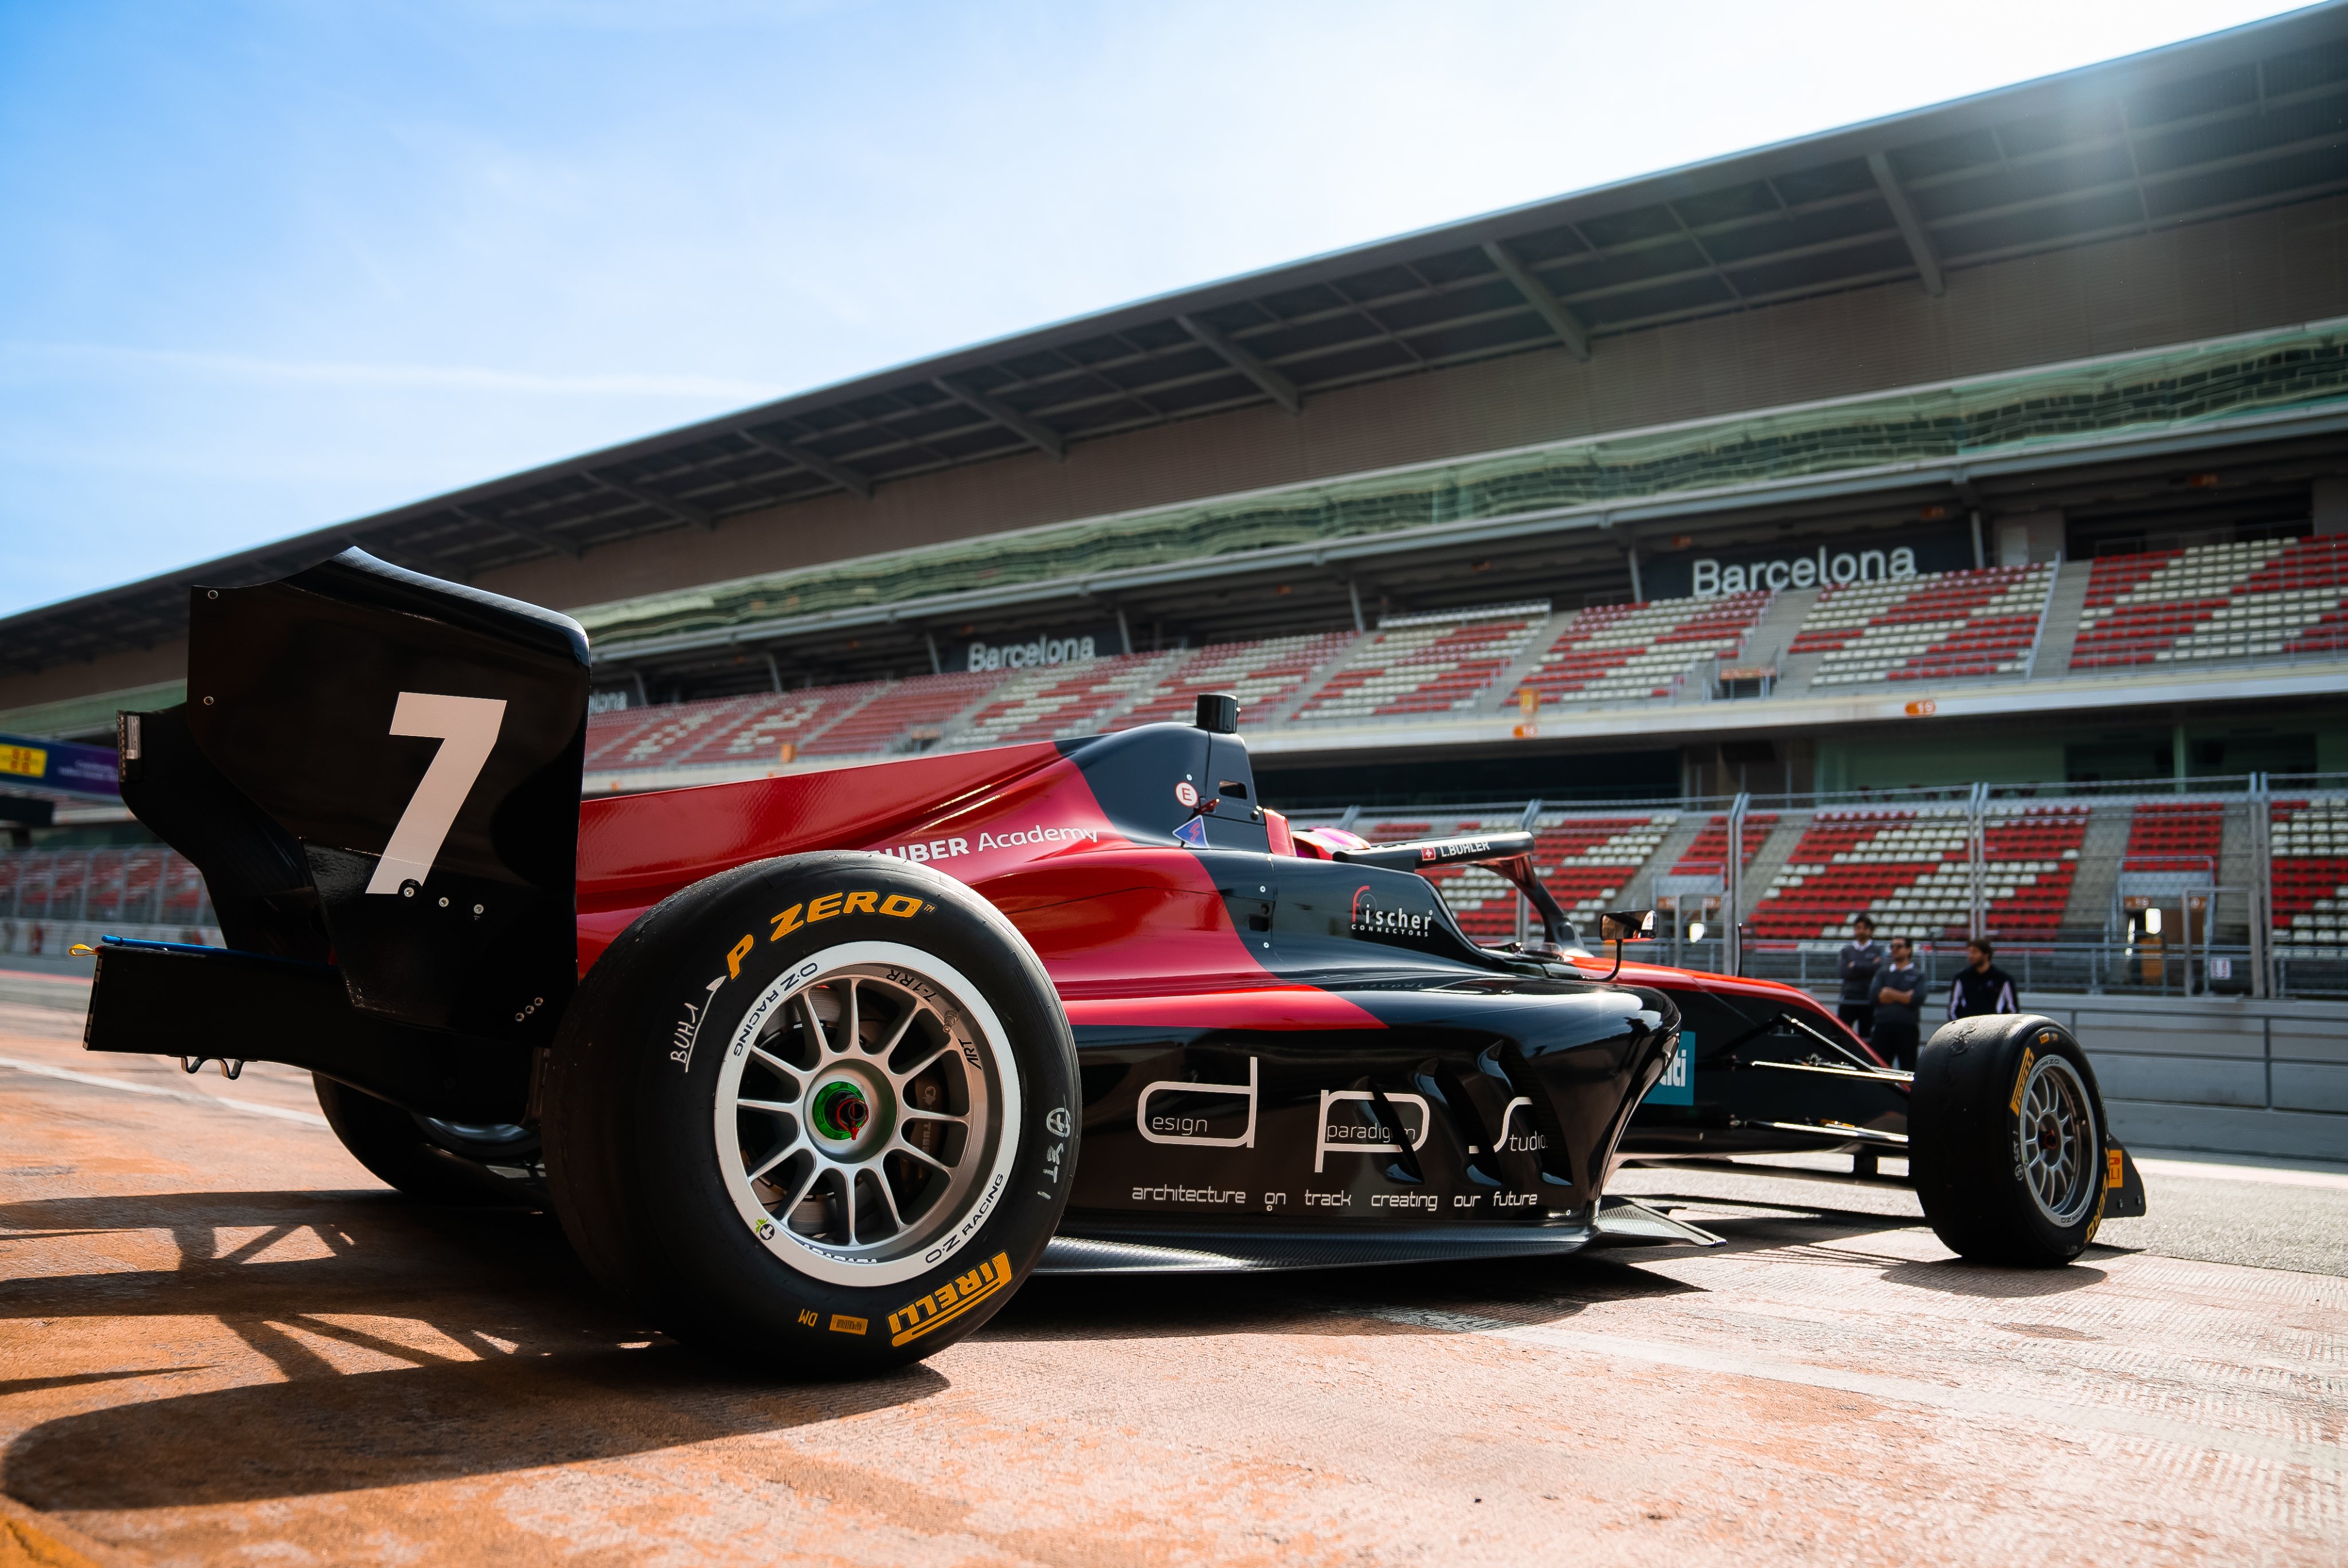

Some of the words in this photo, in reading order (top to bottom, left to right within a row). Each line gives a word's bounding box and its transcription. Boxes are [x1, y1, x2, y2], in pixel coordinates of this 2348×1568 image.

[1693, 545, 1916, 597] Barcelona
[967, 633, 1096, 672] Barcelona
[366, 692, 507, 893] 7
[1181, 787, 1192, 801] E
[978, 825, 1098, 852] Academy
[727, 935, 754, 980] P
[770, 892, 923, 942] ZERO
[1351, 924, 1429, 937] CONNECTORS
[733, 989, 779, 1057] RACING
[961, 1173, 1004, 1236] RACING
[1132, 1183, 1246, 1204] architecture
[1265, 1191, 1286, 1205] on
[1305, 1190, 1352, 1207] track
[1371, 1191, 1438, 1212] creating
[1454, 1195, 1481, 1208] our
[1493, 1191, 1538, 1206] future
[798, 1308, 819, 1327] DM
[888, 1252, 1012, 1347] PIRELLI
